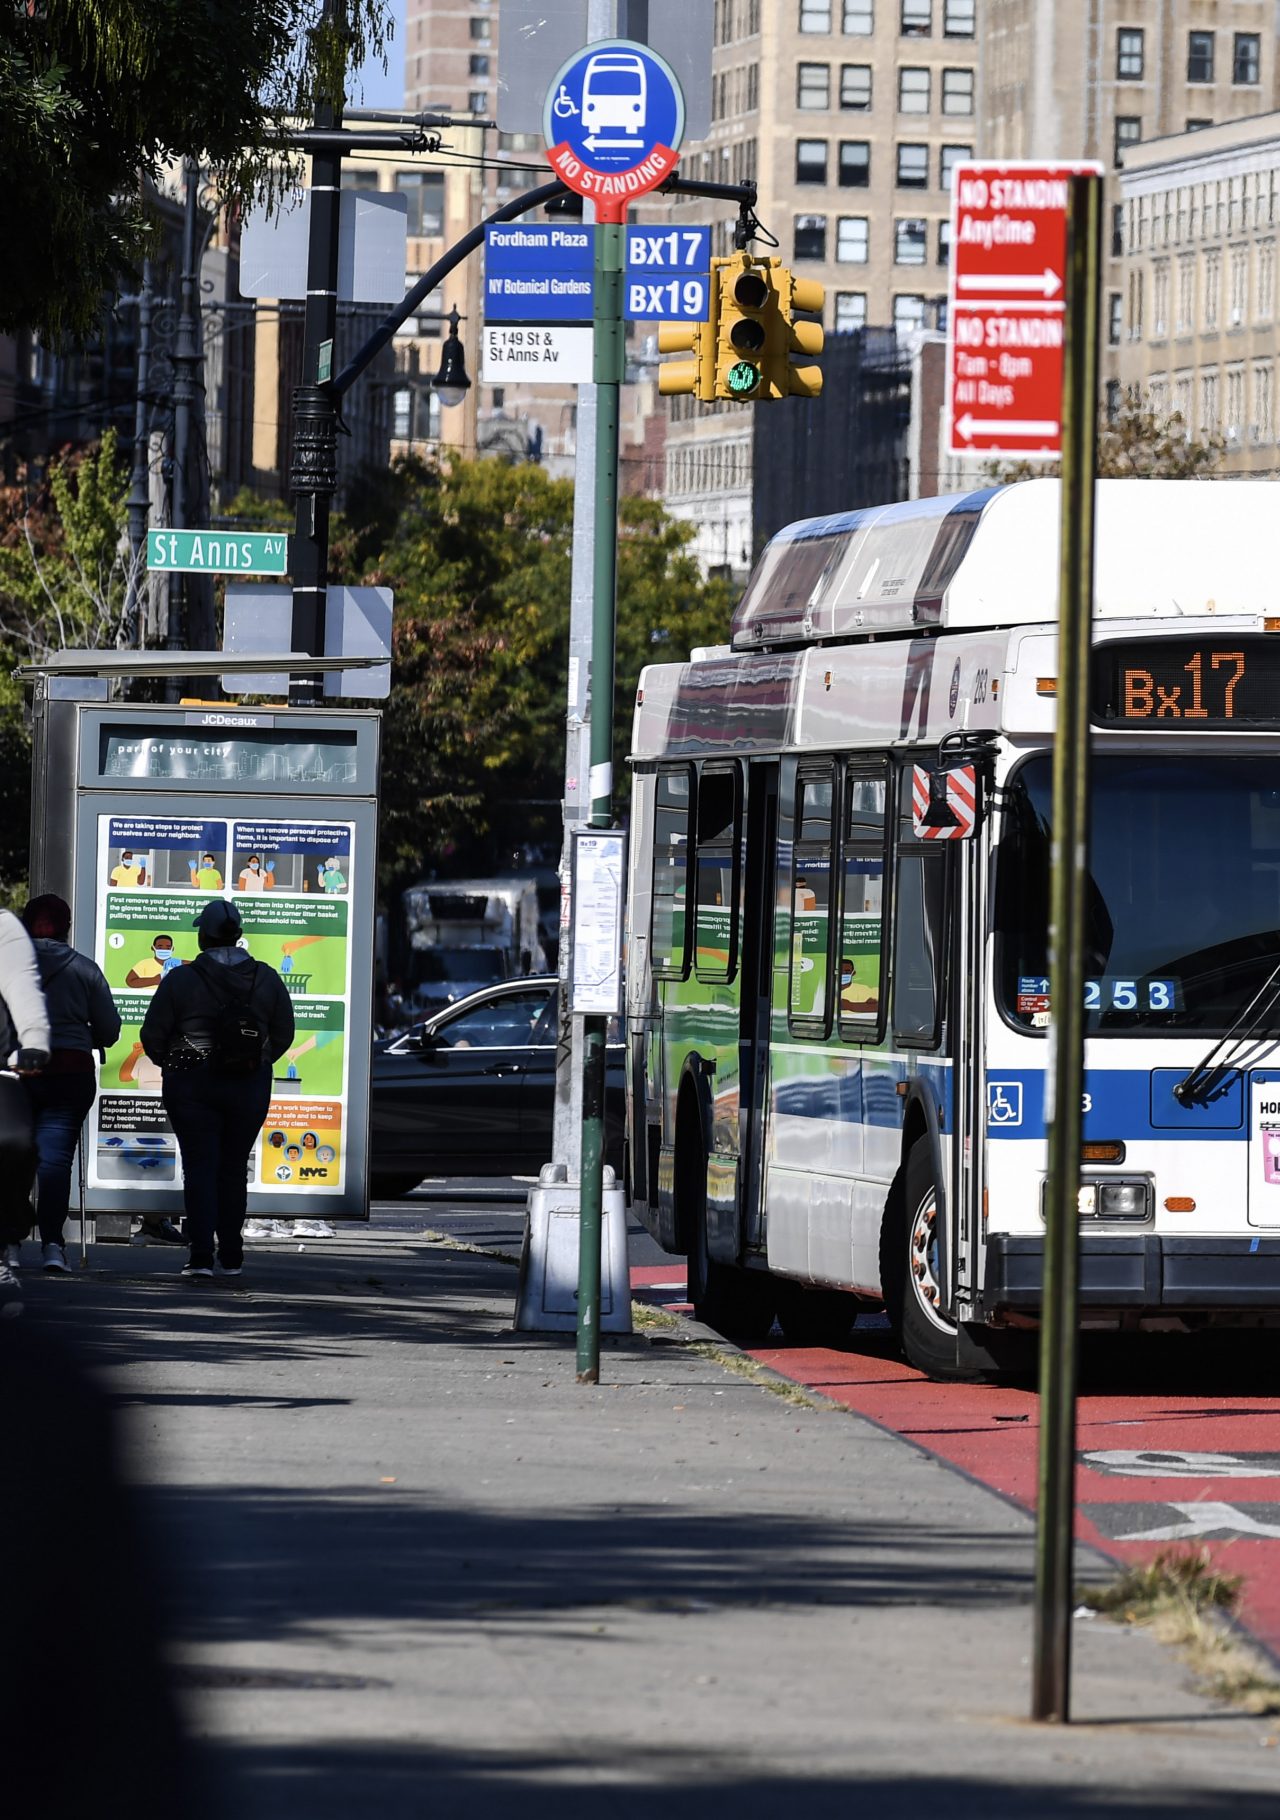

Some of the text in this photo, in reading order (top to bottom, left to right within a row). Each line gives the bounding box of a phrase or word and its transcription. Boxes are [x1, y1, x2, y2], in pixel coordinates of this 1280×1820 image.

[556, 150, 667, 195] NO STANDING
[959, 179, 1068, 210] NO STANDIN
[489, 231, 588, 247] Fordham Plaza
[958, 215, 1037, 250] Anytime
[629, 232, 702, 265] BX17
[489, 279, 591, 295] NY Botanical Gardens
[629, 280, 703, 314] BX19
[489, 332, 553, 345] E 149 St &
[956, 317, 1064, 348] NO STANDIN
[489, 348, 559, 362] St Anns Av
[955, 353, 988, 376] 7am
[955, 381, 1014, 409] All Days
[154, 534, 282, 568] St Anns Av
[1124, 652, 1246, 718] Bx17
[202, 715, 257, 726] JCDecaux
[151, 744, 164, 754] of
[170, 746, 198, 756] your
[204, 746, 230, 758] city
[135, 822, 154, 830] taking
[155, 823, 172, 831] steps
[269, 835, 298, 843] important
[165, 898, 186, 906] gloves
[113, 936, 119, 945] 1
[1084, 981, 1170, 1010] 253
[140, 1007, 148, 1015] by
[135, 1100, 162, 1108] properly
[299, 1105, 325, 1113] together
[299, 1167, 328, 1178] NYC
